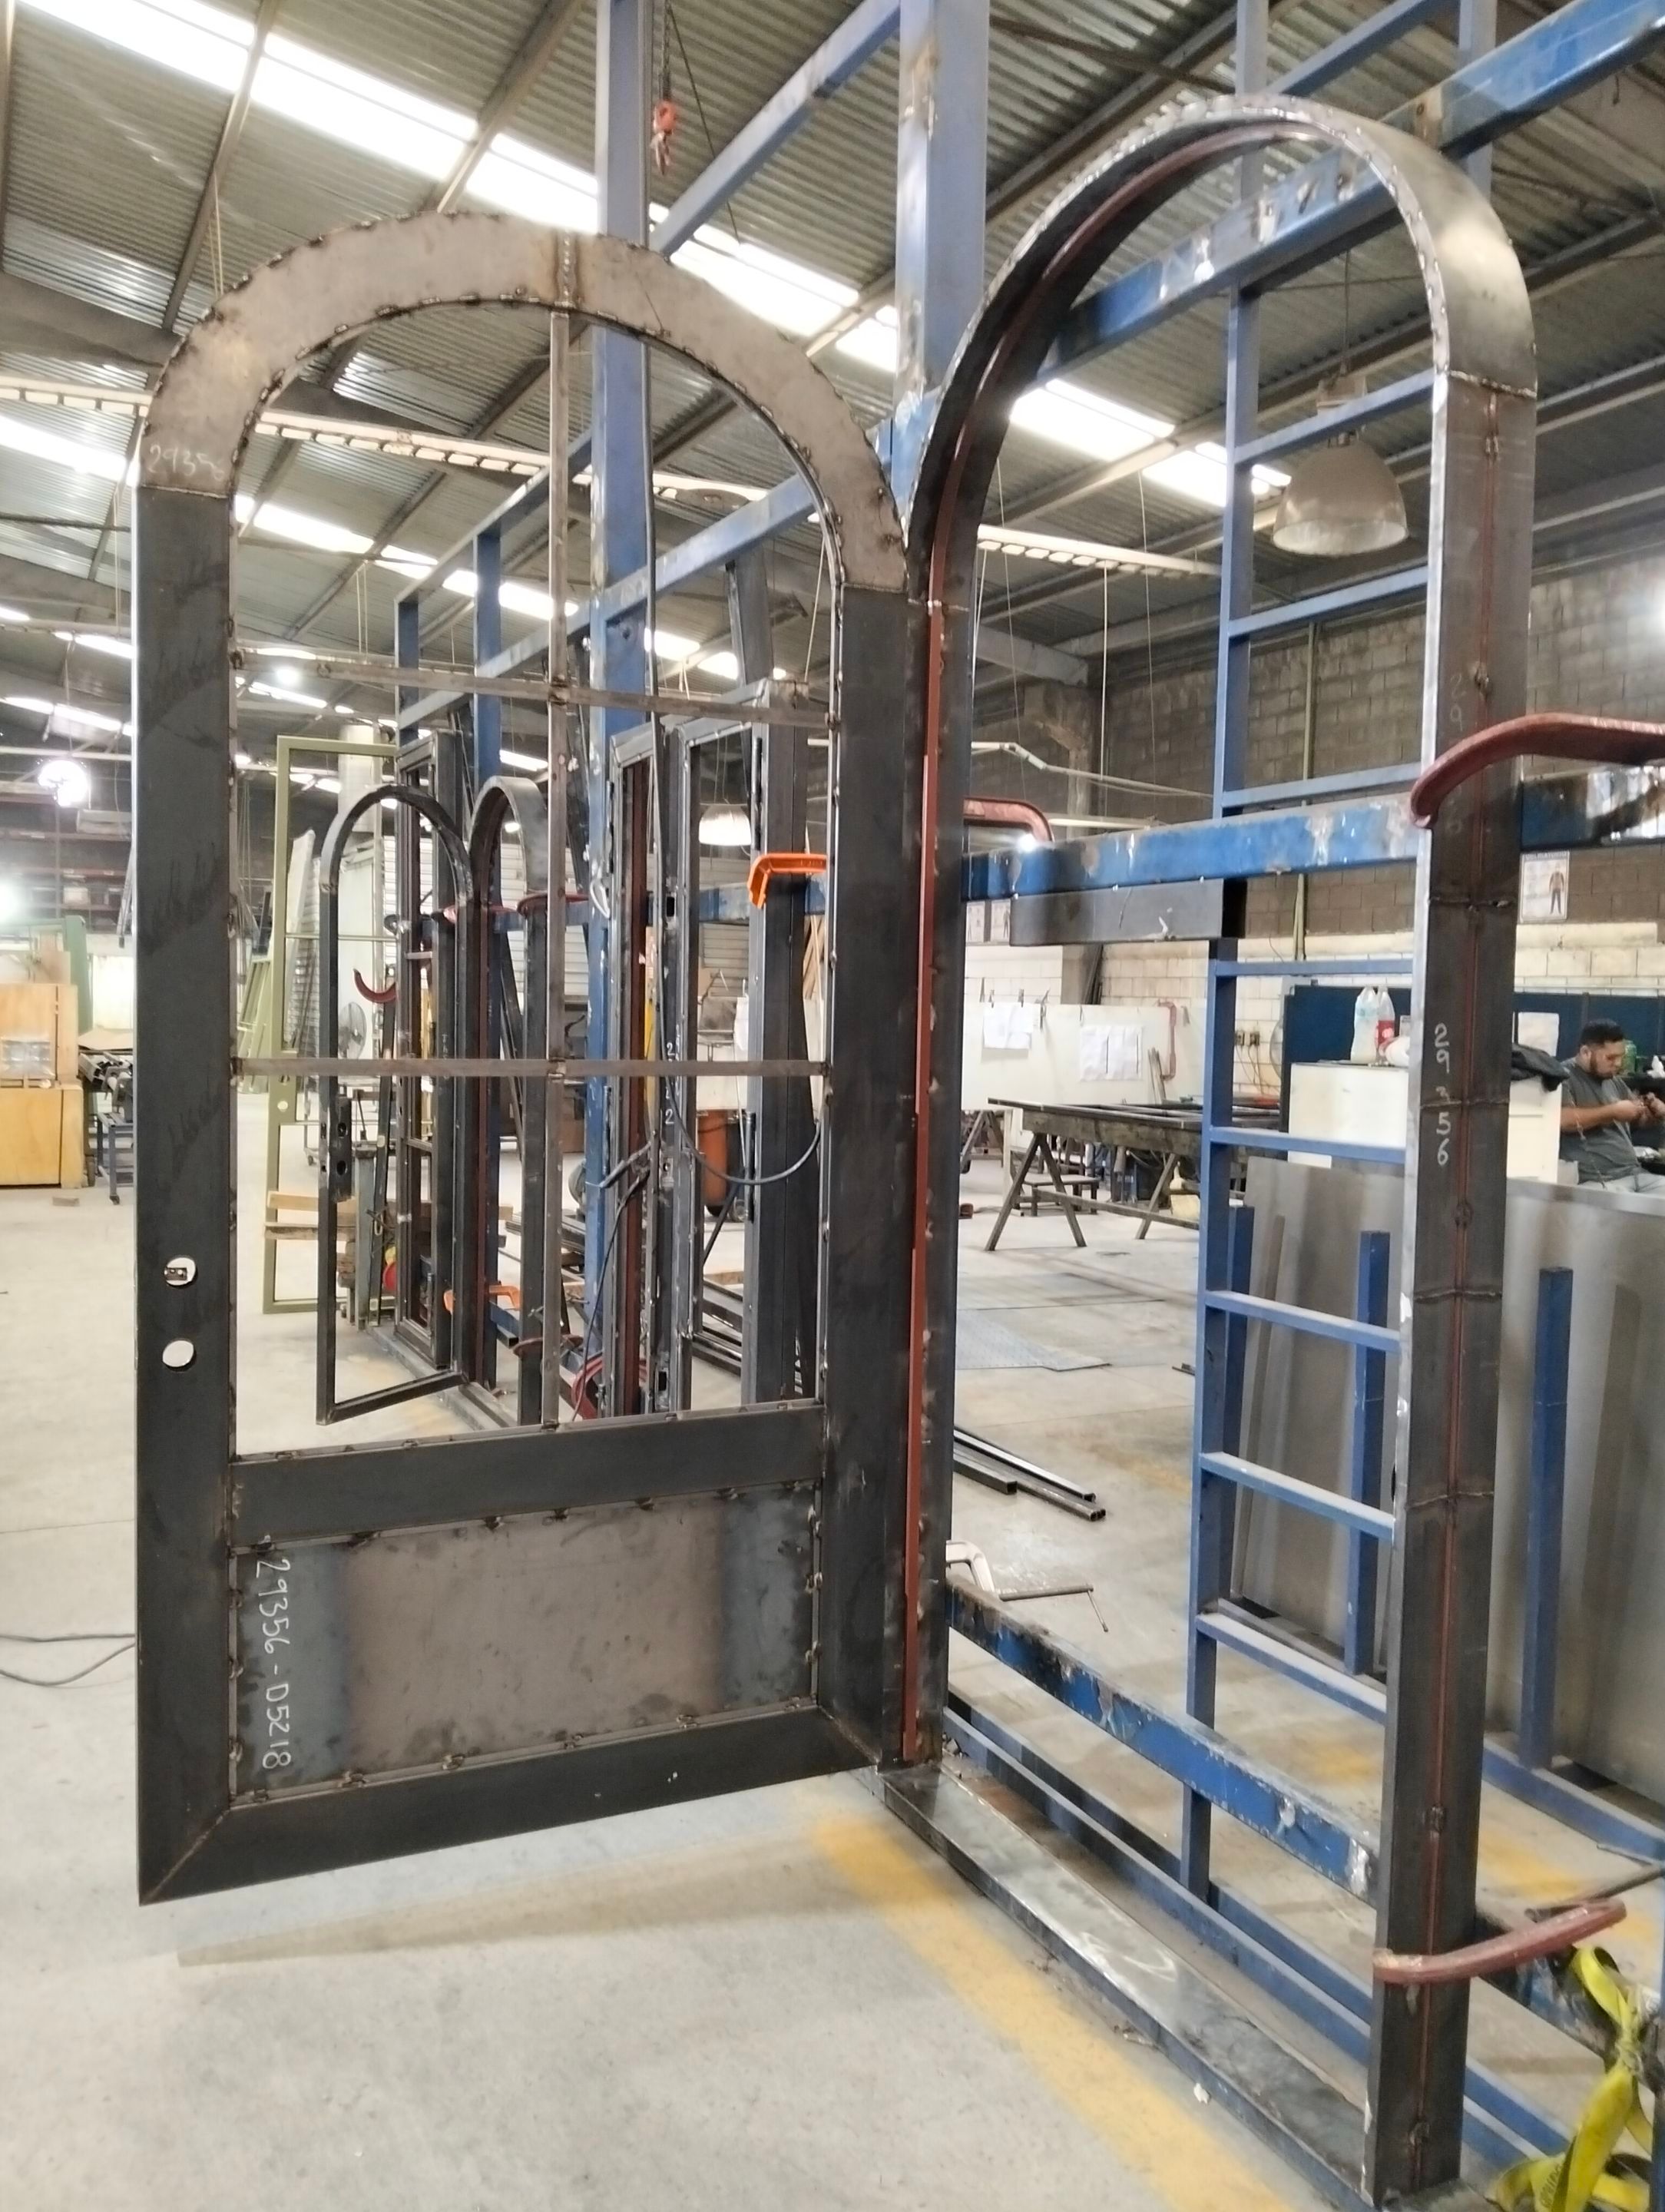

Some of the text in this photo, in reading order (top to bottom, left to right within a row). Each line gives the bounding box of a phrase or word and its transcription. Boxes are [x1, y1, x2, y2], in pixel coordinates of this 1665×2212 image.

[147, 443, 225, 482] 29356
[256, 1558, 291, 1654] 29356
[262, 1683, 292, 1770] D5218
